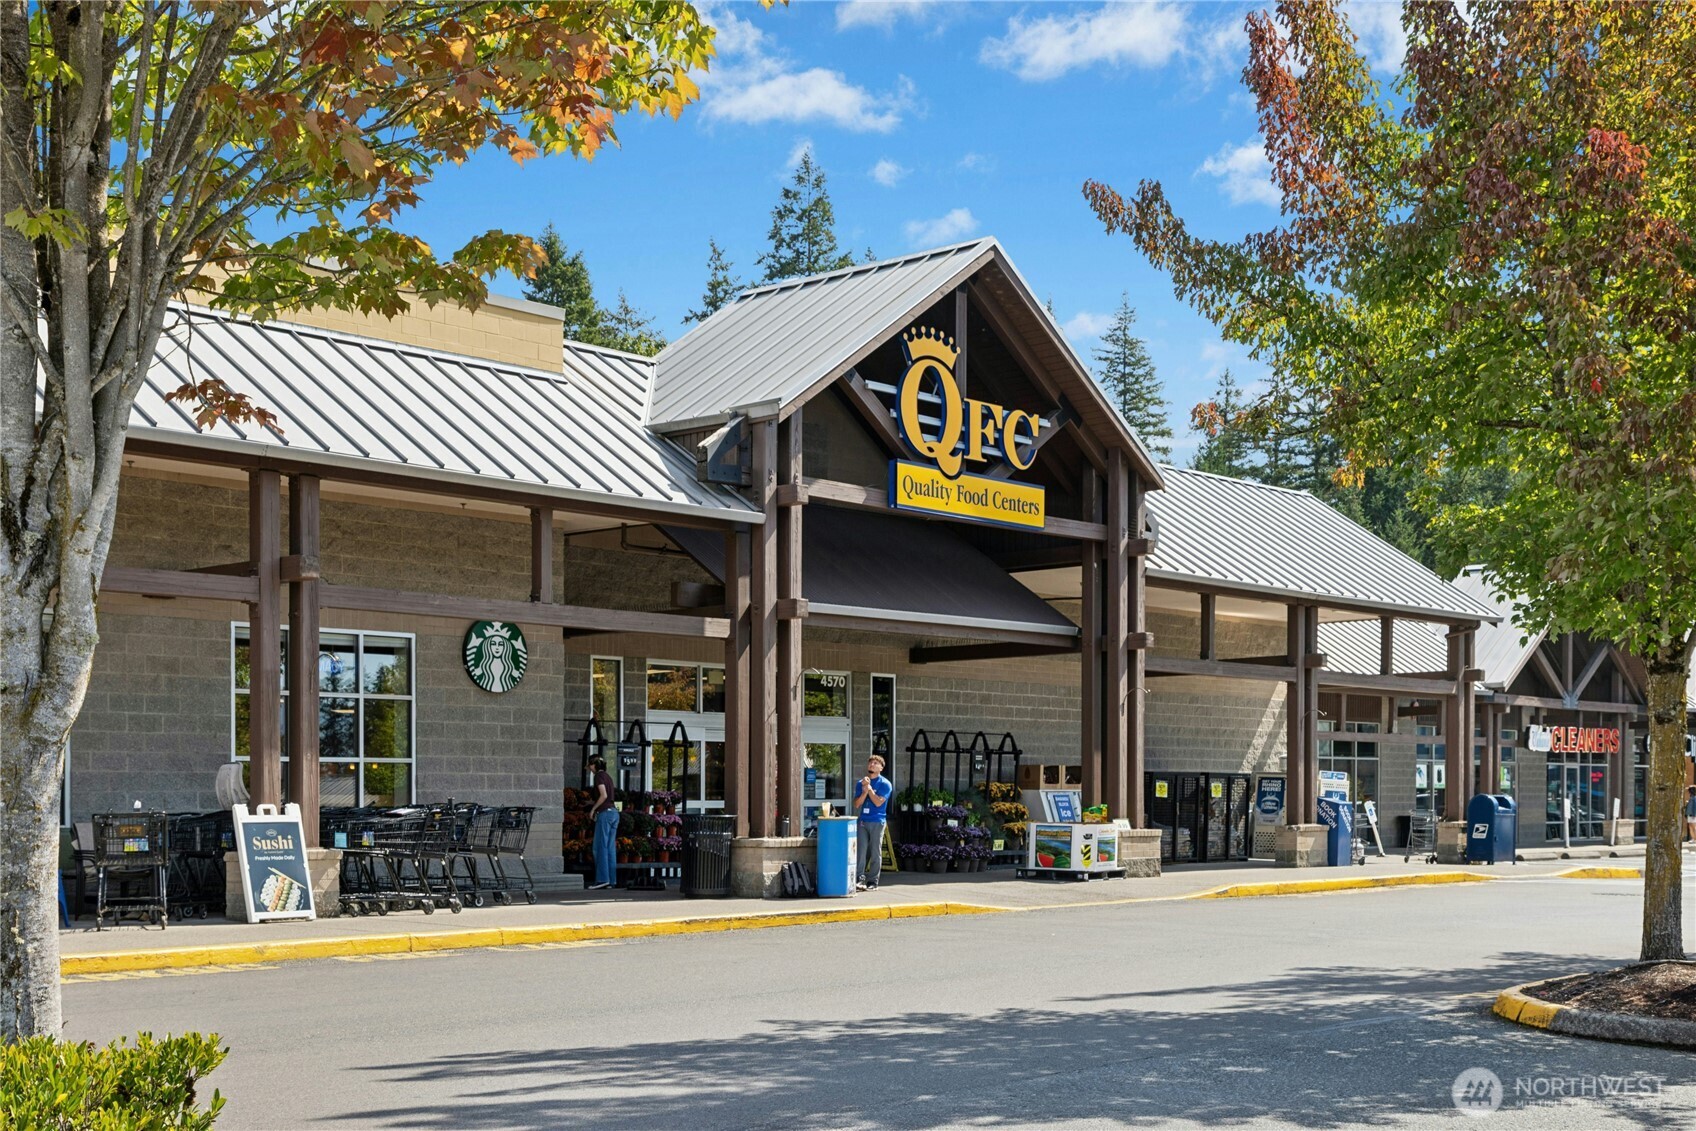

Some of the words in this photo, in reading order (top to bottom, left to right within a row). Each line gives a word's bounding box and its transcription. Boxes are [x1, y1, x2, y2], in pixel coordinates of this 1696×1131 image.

[899, 358, 1040, 480] QFC
[902, 474, 953, 506] Quality
[956, 484, 989, 507] Food
[992, 490, 1040, 516] Centers
[820, 676, 845, 687] 4570
[1552, 727, 1619, 753] CLEANERS
[1060, 809, 1071, 817] Ice
[1316, 806, 1337, 828] ONATION
[1320, 801, 1337, 818] BOOK
[252, 835, 293, 850] Sushi
